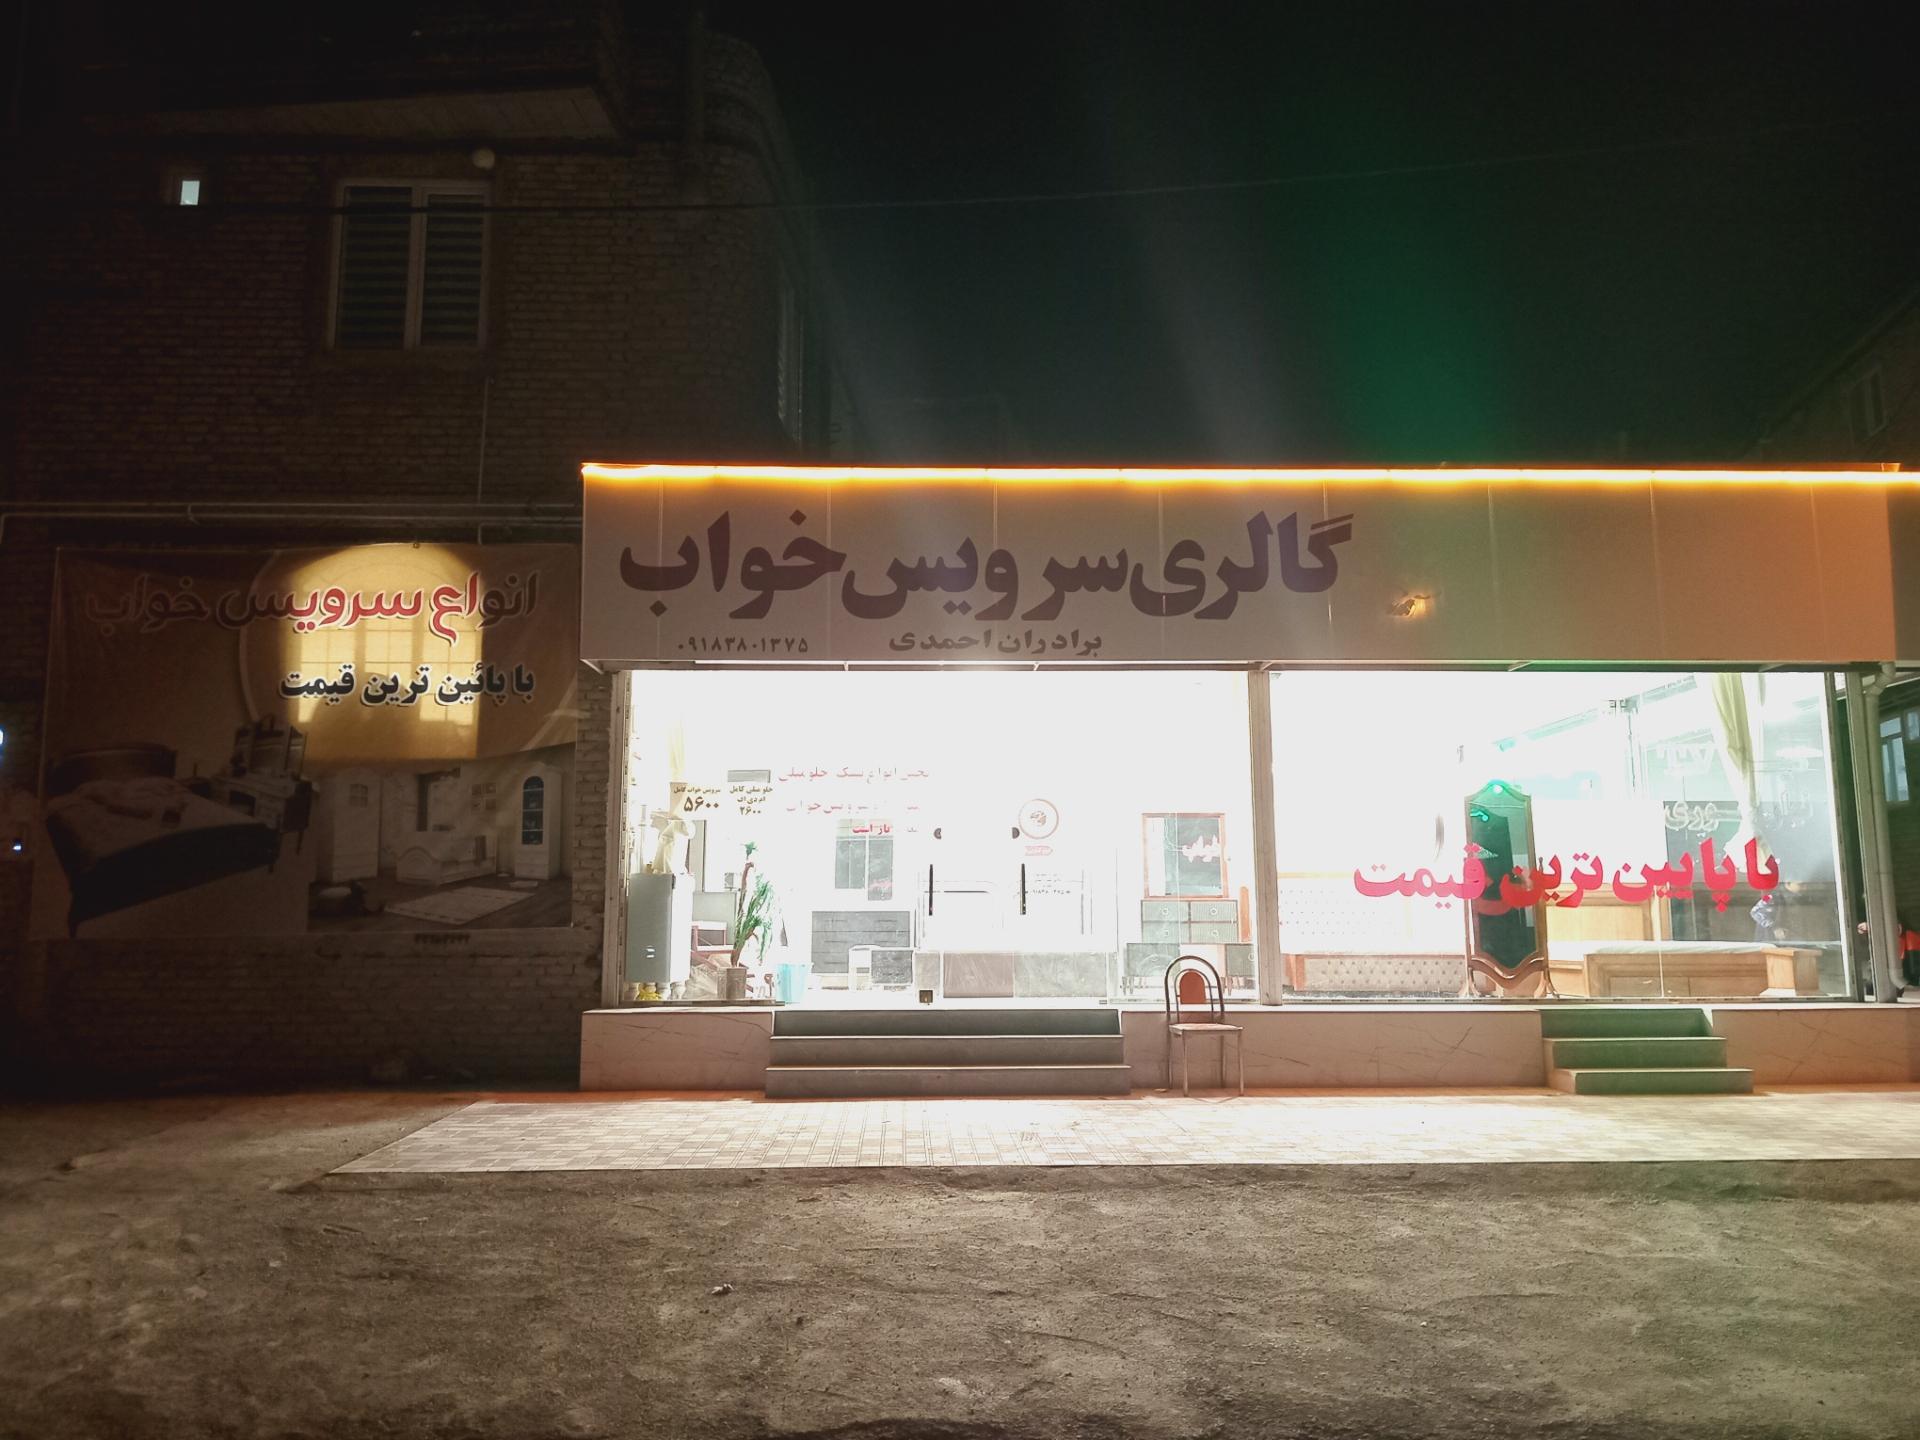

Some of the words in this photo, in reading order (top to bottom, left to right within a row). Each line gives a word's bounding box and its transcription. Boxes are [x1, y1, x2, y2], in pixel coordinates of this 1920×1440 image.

[620, 509, 848, 620] خواب
[841, 536, 1129, 622] سرویس
[1129, 510, 1355, 621] گالری
[86, 574, 210, 637] خواب
[216, 584, 424, 635] سرویس
[427, 570, 540, 648] انواع
[677, 636, 809, 653] ۰۹۱۸۳۸۰۱۳۷۵
[889, 628, 993, 652] احمدی
[997, 628, 1103, 658] برادران
[278, 663, 356, 704] قیمت
[360, 664, 430, 706] ترین
[436, 662, 508, 706] پائین
[512, 662, 536, 702] با
[683, 796, 719, 812] ۵۶۰۰
[1353, 842, 1488, 909] قیمت
[1499, 851, 1604, 908] ترین
[1744, 837, 1779, 902] با
